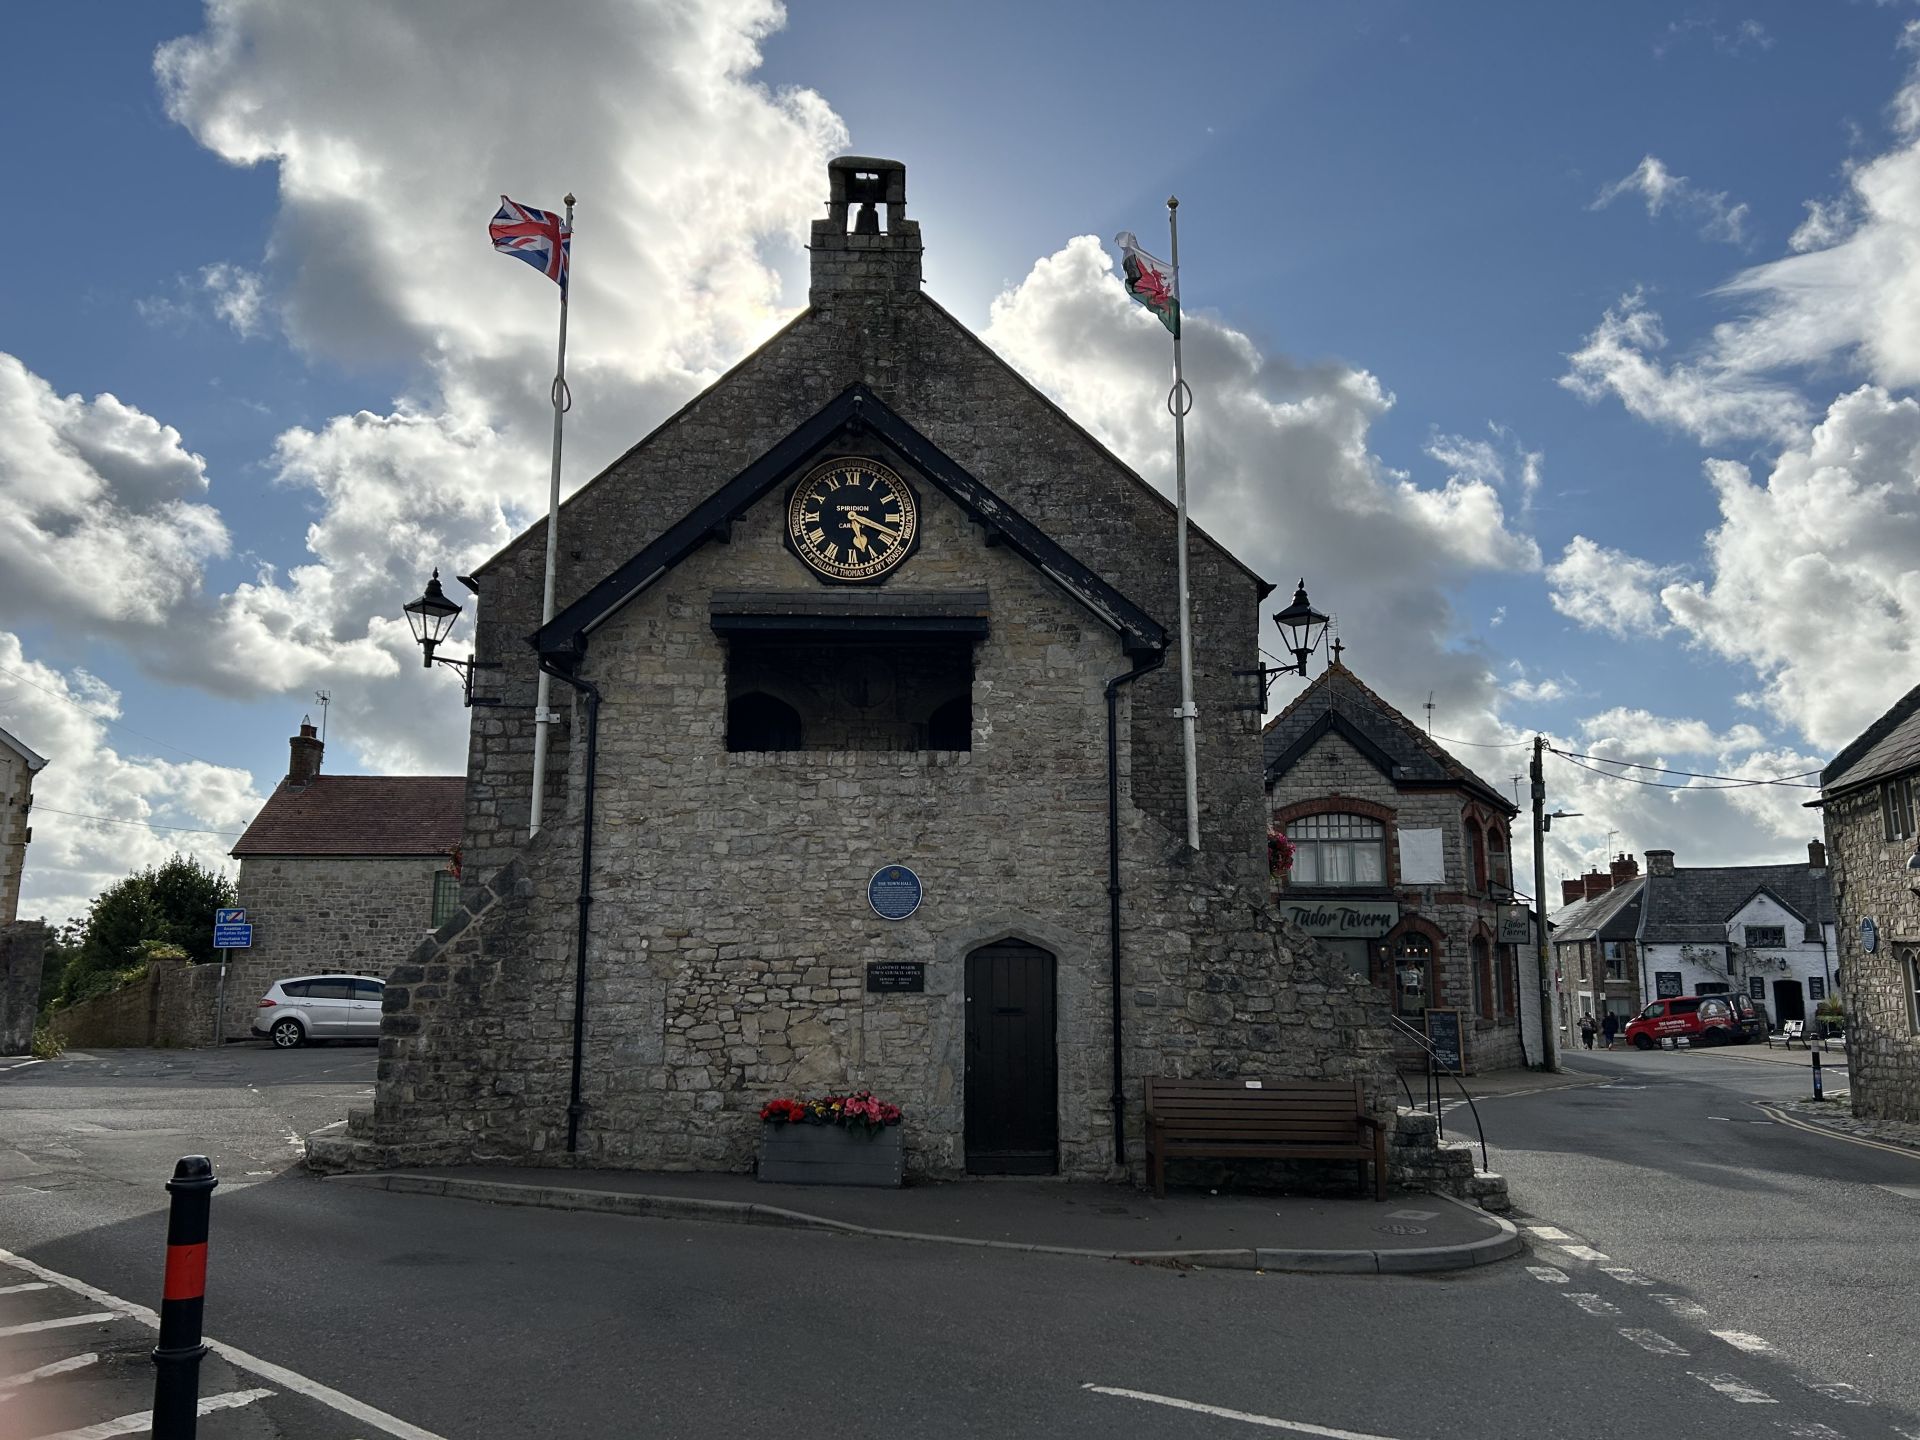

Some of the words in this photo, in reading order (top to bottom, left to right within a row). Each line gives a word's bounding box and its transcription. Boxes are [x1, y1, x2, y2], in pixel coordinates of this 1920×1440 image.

[846, 459, 880, 471] JUBILEE
[845, 471, 861, 486] XII
[878, 466, 899, 484] YEAR
[894, 480, 905, 491] OF
[795, 490, 805, 500] TO
[880, 492, 896, 505] II
[899, 488, 914, 510] QUEEN
[791, 498, 802, 536] PRESENTED
[885, 513, 900, 523] III
[902, 510, 914, 541] VICTORIA
[799, 542, 810, 554] BY
[811, 556, 838, 574] WILLIAM
[837, 568, 865, 577] THOMAS
[865, 566, 875, 575] OF
[874, 560, 888, 572] IVY
[885, 544, 905, 565] HOUSE
[1288, 905, 1337, 927] Tudor
[1336, 907, 1392, 931] Tavern
[1504, 919, 1526, 929] Tudor
[1501, 927, 1527, 937] Tavern
